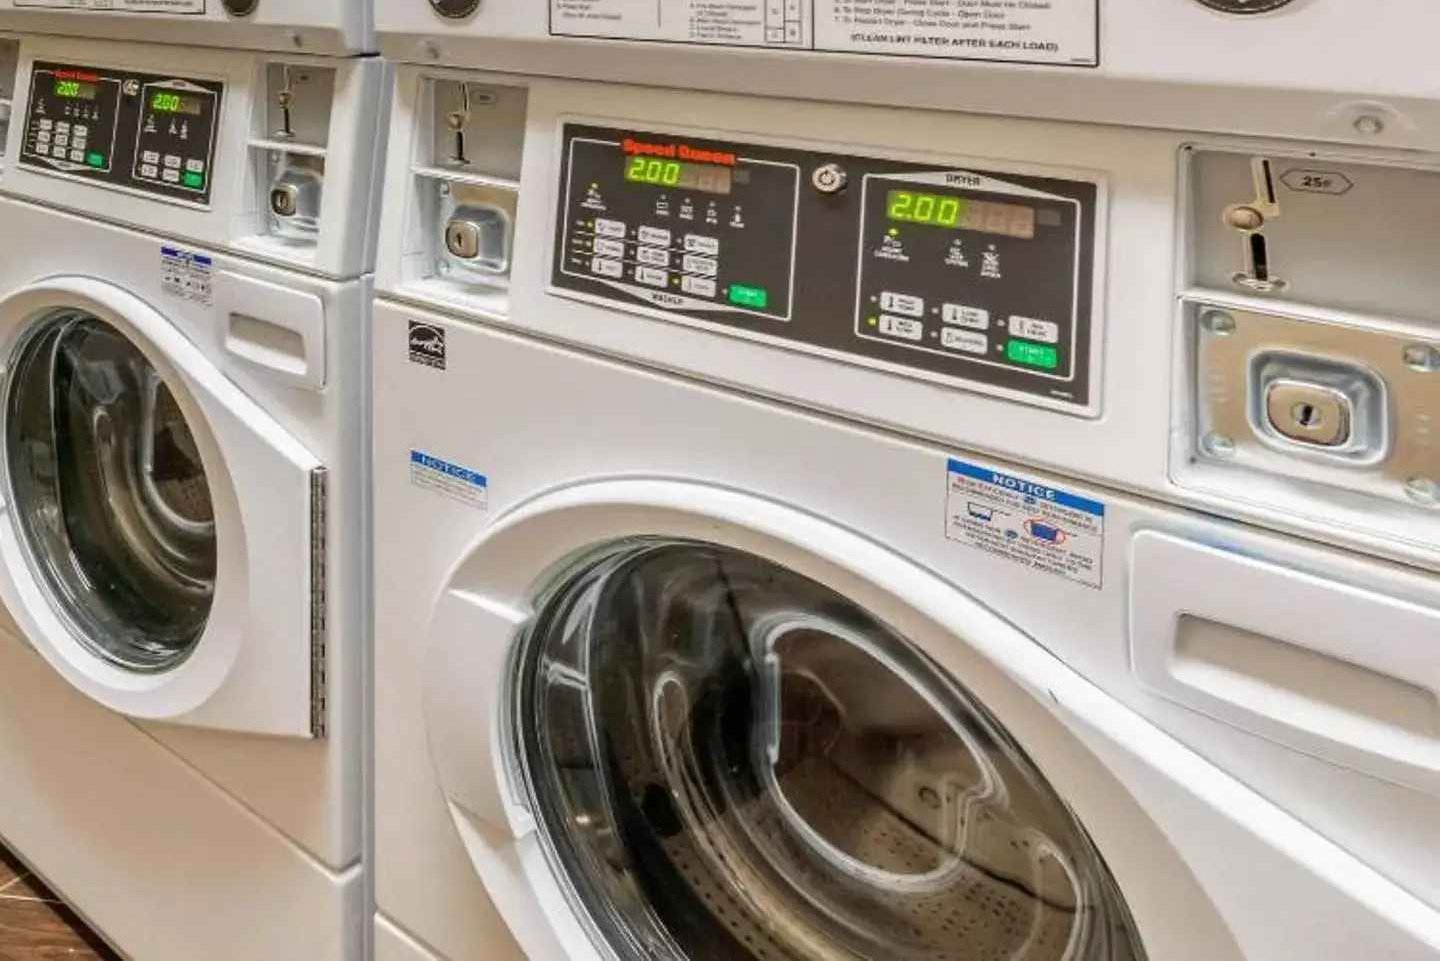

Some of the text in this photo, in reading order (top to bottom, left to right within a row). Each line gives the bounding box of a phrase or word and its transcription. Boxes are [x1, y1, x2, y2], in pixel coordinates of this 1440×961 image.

[621, 139, 736, 165] Speed Queen
[628, 158, 680, 185] 2.00
[945, 173, 981, 186] DRYER
[890, 193, 959, 226] 2.00
[992, 474, 1057, 500] NOTICE
